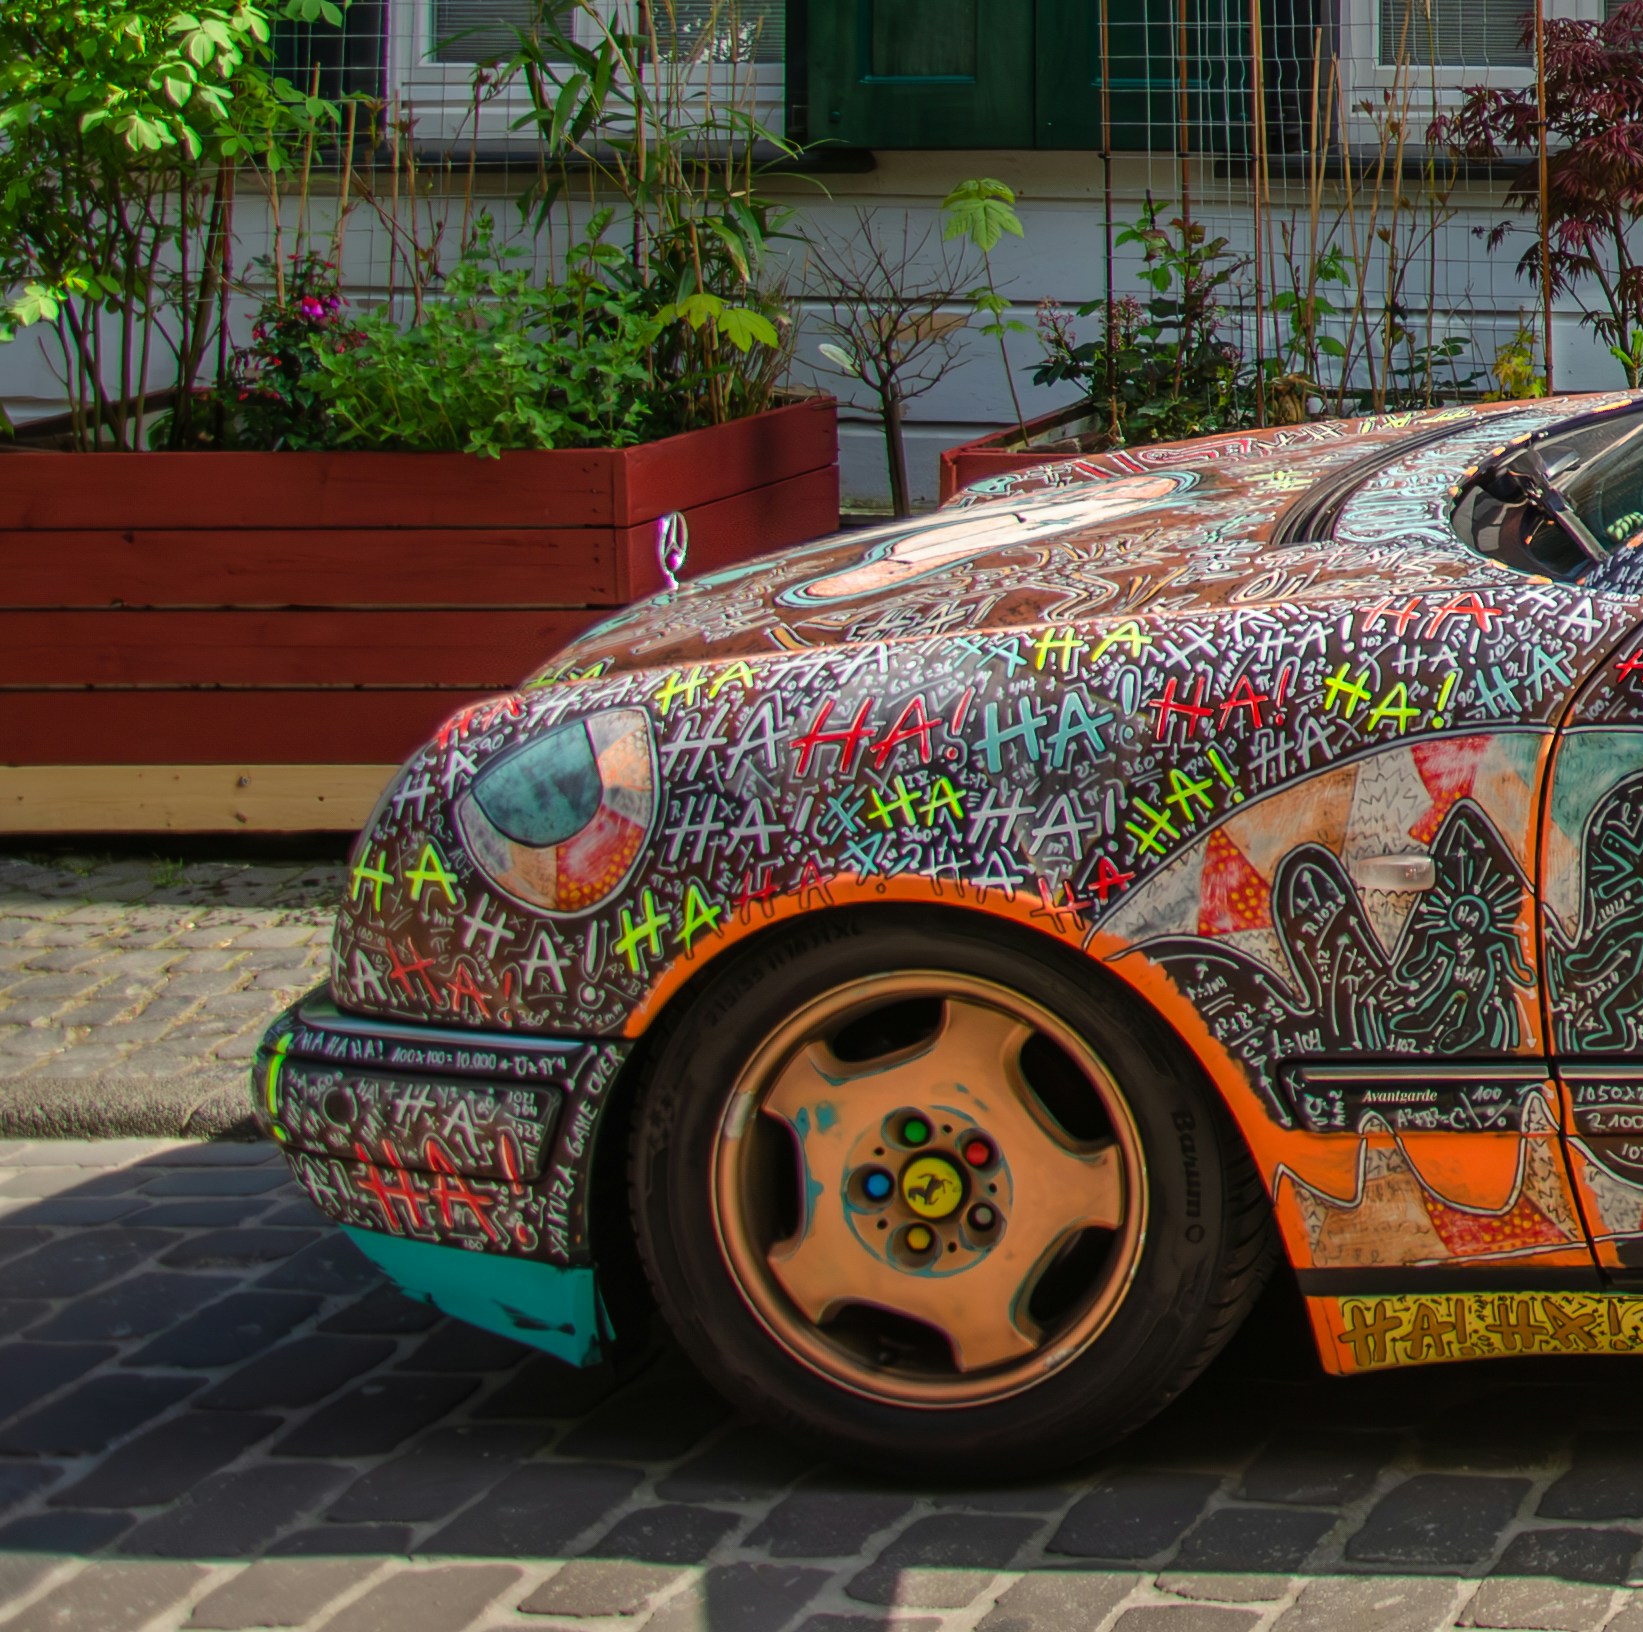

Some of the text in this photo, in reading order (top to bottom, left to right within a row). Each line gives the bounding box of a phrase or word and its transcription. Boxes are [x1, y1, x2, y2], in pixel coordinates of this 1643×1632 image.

[1034, 620, 1153, 671] HA
[1360, 592, 1503, 639] HA
[658, 660, 761, 715] HA
[1150, 668, 1290, 740] HA!
[1325, 662, 1456, 735] HA!
[661, 690, 789, 780] HA
[790, 687, 974, 775] HA!
[868, 775, 967, 829] HA
[1126, 748, 1245, 855] HA!
[352, 841, 458, 912] HA
[616, 884, 723, 972] HA
[1362, 1088, 1438, 1104] Avantgarde
